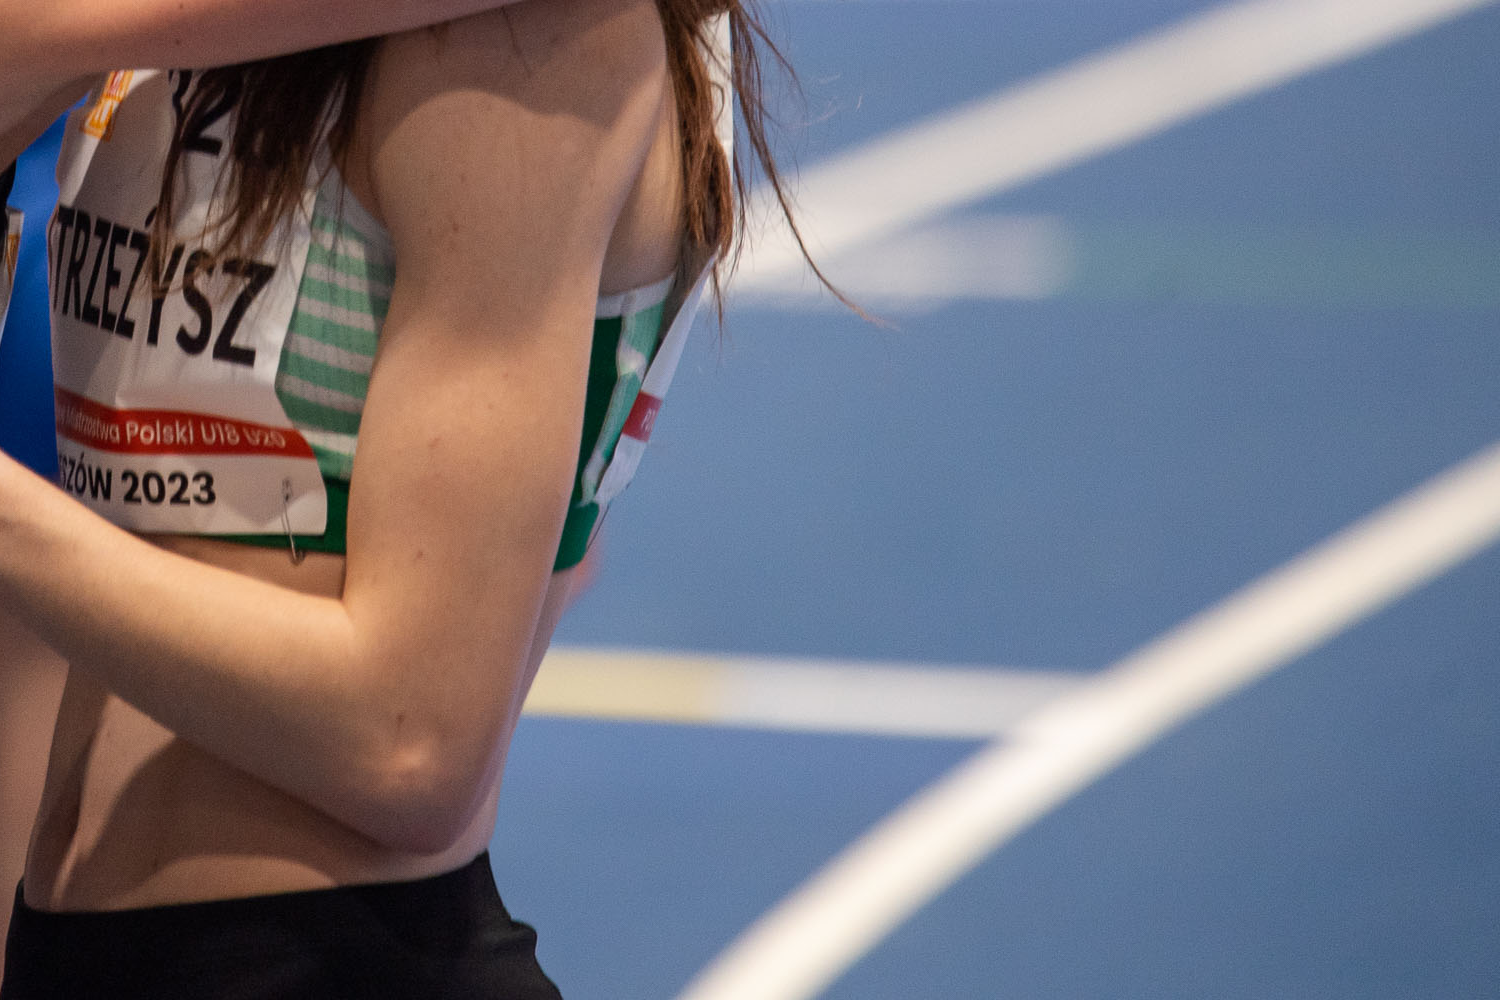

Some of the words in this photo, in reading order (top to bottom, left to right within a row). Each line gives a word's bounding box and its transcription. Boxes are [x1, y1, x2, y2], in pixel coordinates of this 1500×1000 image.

[125, 418, 195, 446] Polski
[201, 420, 241, 446] U18
[120, 469, 217, 507] 2023
